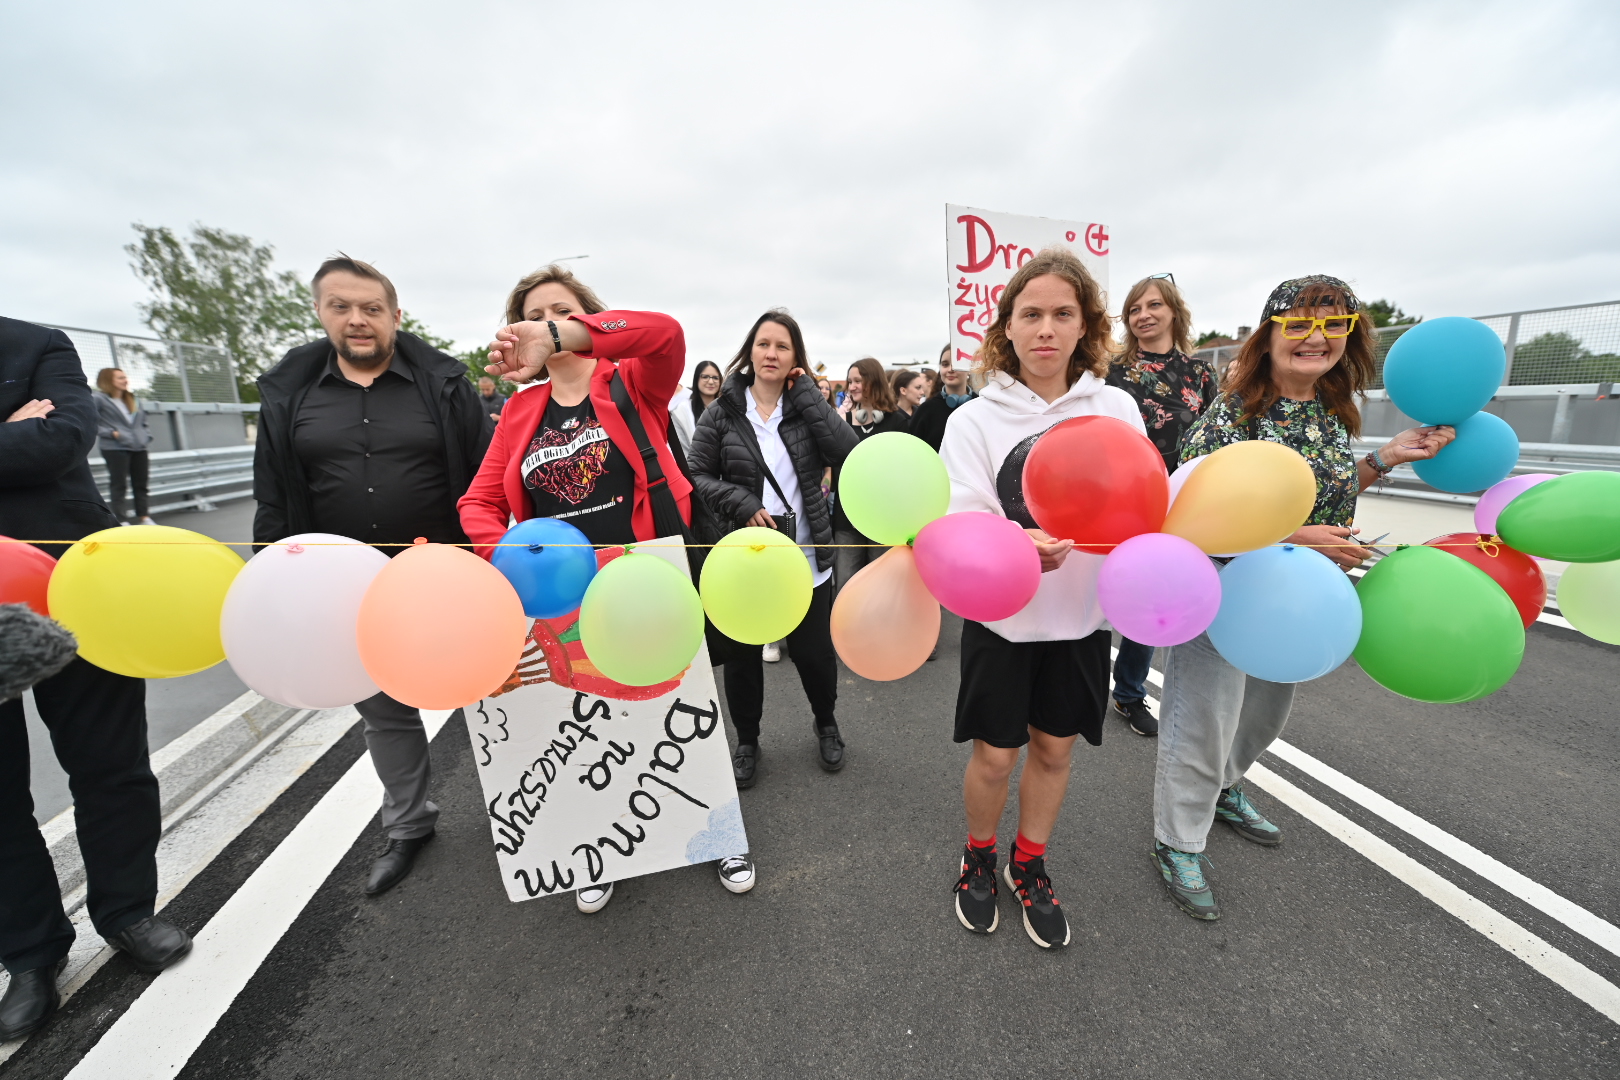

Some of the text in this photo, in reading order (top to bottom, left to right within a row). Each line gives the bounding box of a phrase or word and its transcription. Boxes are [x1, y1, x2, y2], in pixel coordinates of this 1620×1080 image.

[956, 214, 1077, 275] Dro
[578, 740, 636, 792] na
[514, 697, 719, 897] Balonem
